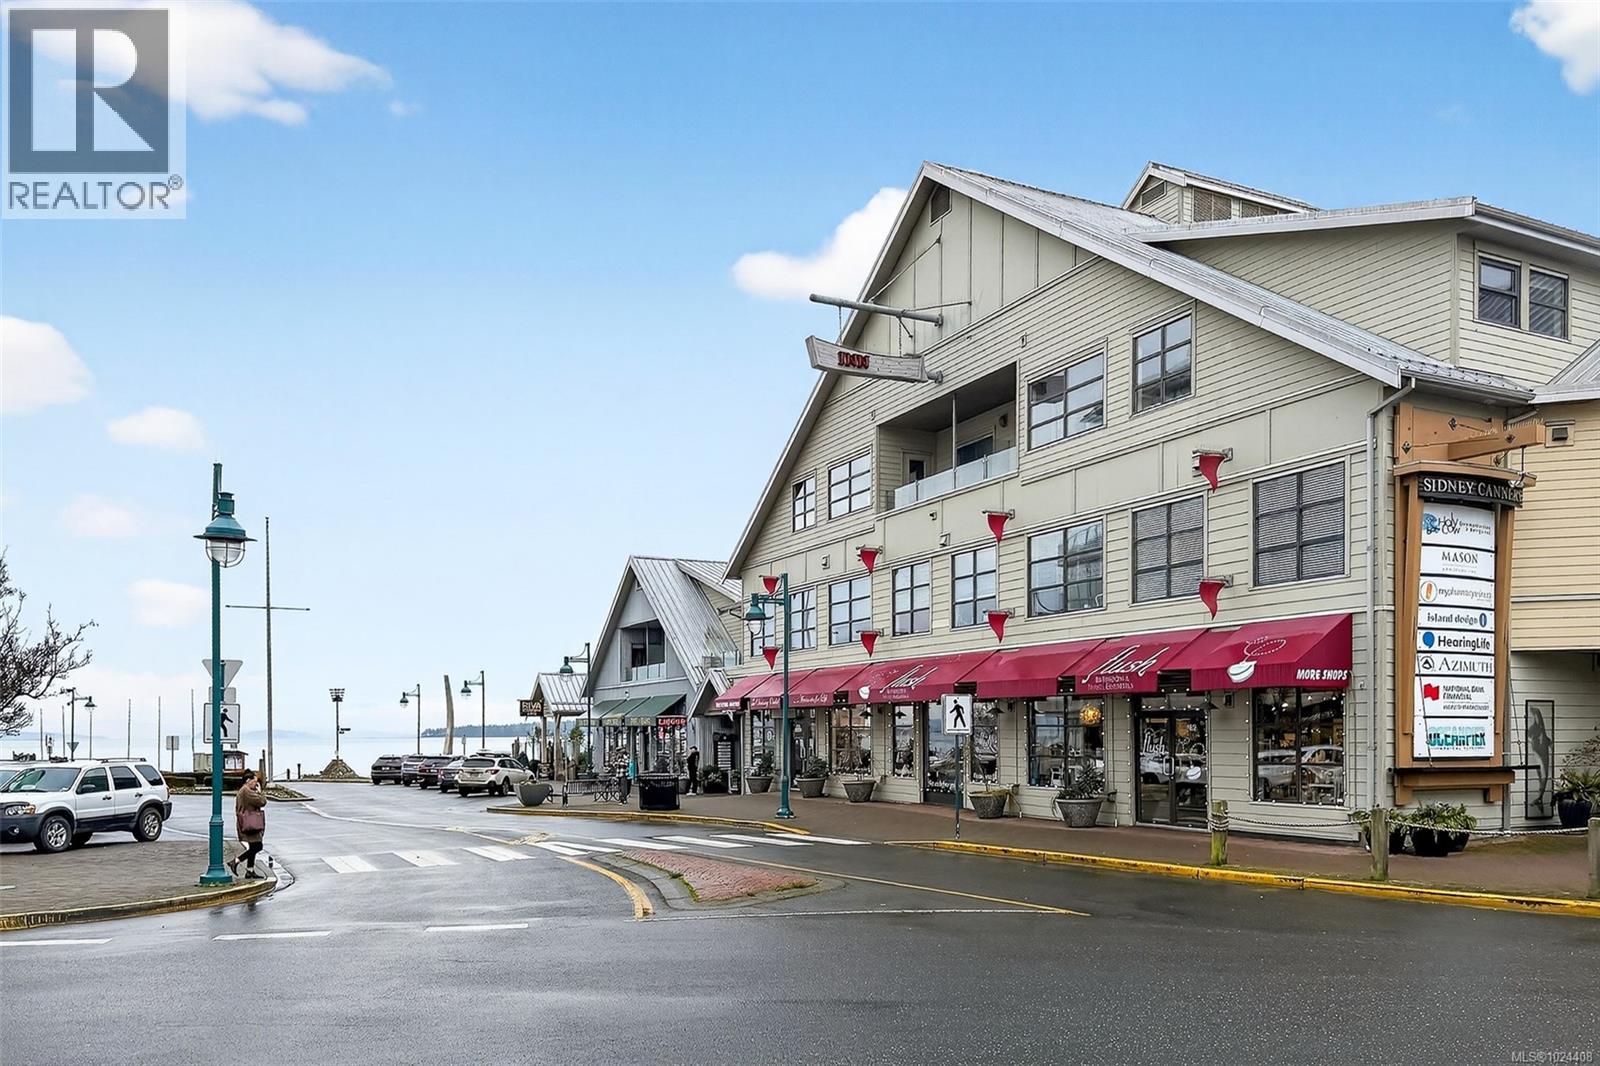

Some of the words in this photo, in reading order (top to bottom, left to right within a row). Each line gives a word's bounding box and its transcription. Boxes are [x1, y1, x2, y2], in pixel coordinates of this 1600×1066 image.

[1423, 478, 1474, 494] SIDNEY
[1441, 551, 1478, 564] MASON
[1427, 612, 1453, 623] island
[1437, 635, 1491, 652] HearingLife
[1438, 657, 1493, 674] AZIMUTH
[1296, 669, 1321, 680] MORE
[1322, 669, 1348, 680] SHOPS
